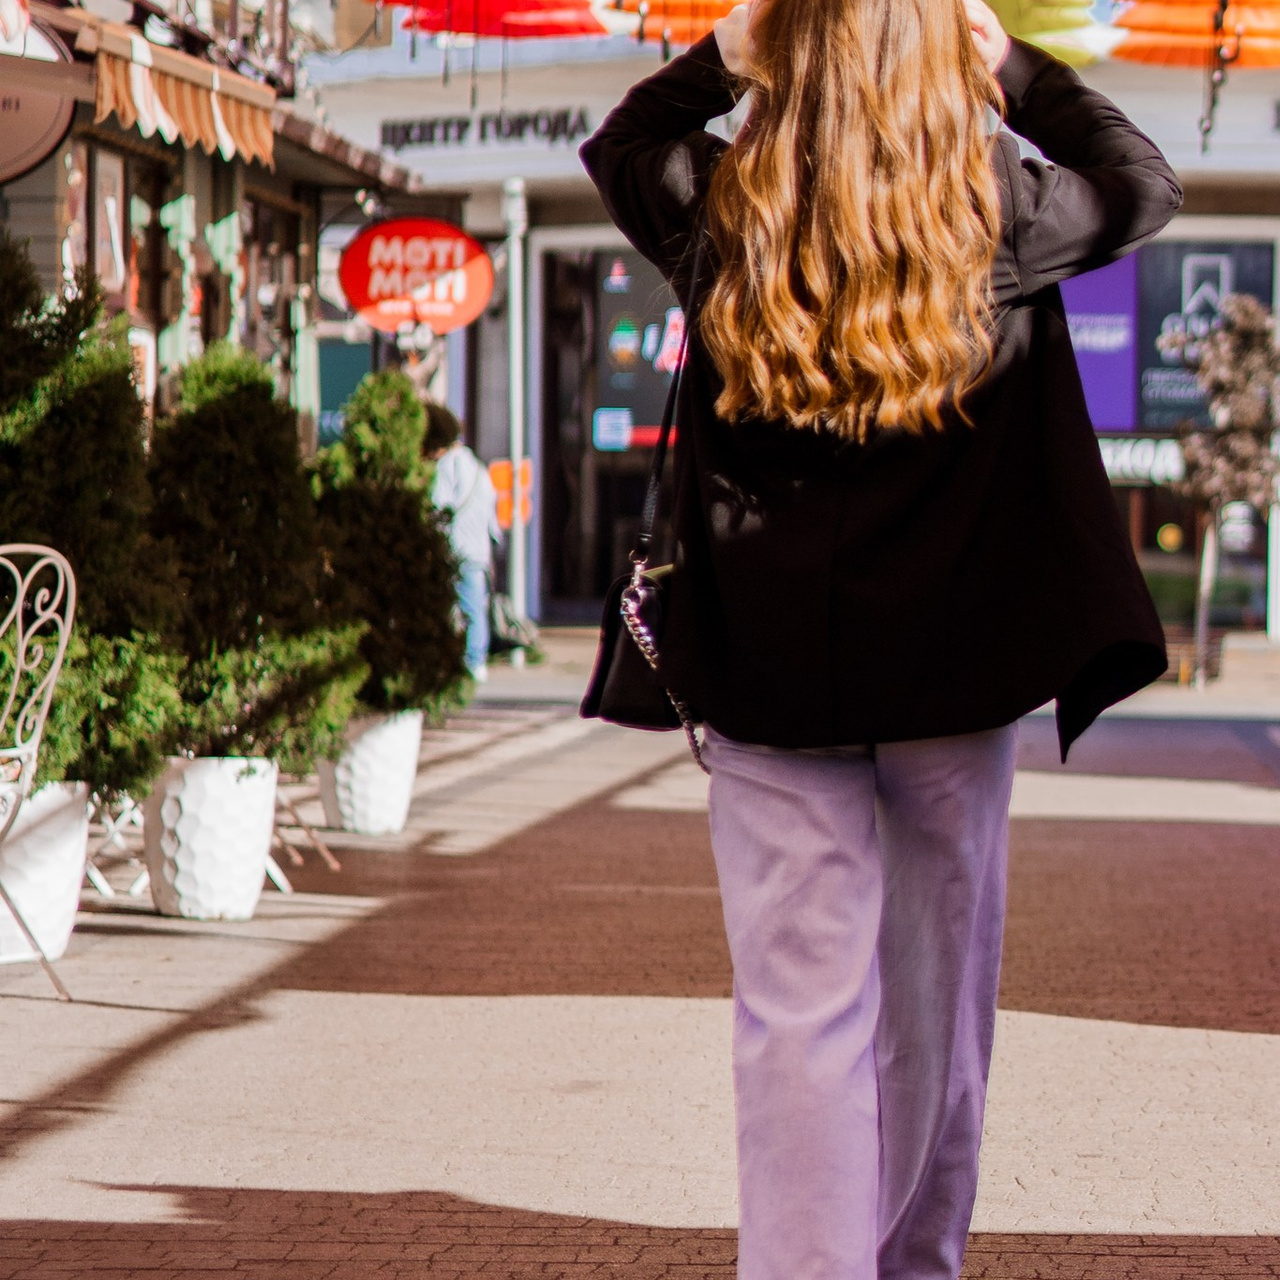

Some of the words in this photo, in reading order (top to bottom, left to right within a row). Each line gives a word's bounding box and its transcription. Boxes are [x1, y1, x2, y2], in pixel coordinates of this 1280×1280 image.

[478, 106, 588, 149] ГОРОДА
[368, 235, 467, 268] MOTI
[368, 267, 467, 304] MOTI
